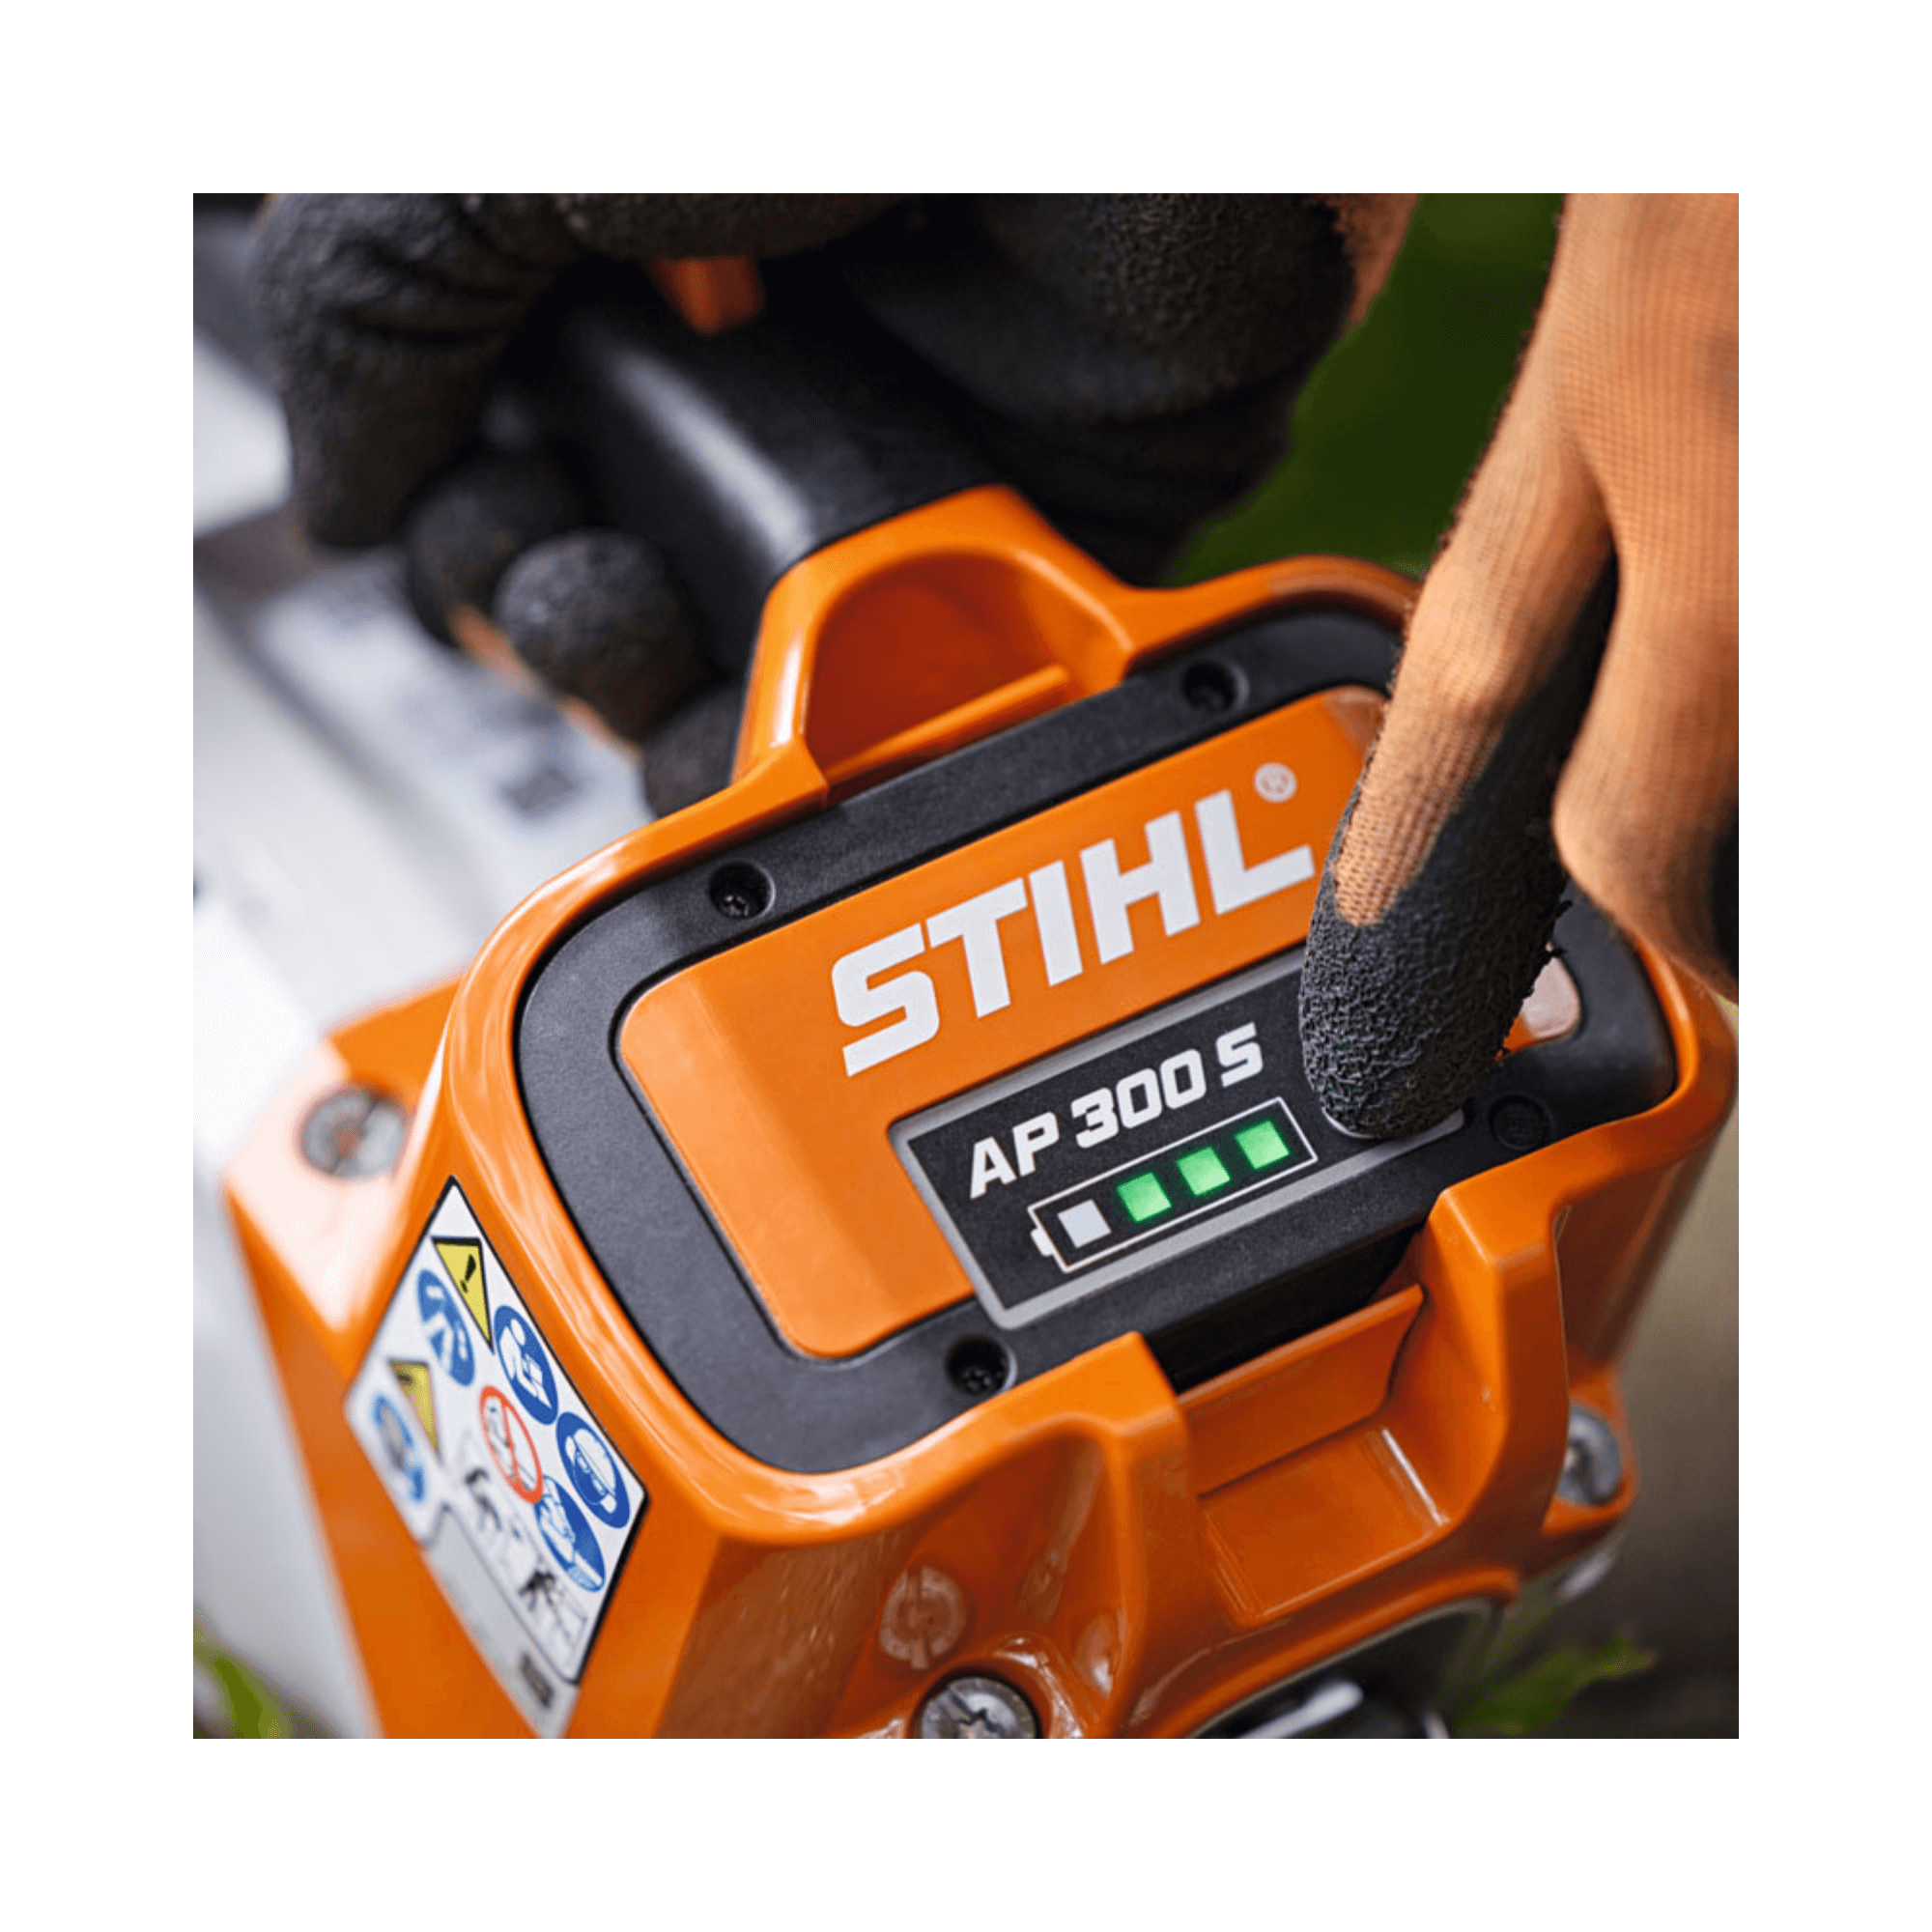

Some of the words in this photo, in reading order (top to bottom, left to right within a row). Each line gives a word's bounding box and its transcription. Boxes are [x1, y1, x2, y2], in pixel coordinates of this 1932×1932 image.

[832, 788, 1315, 1077] STIHL
[970, 1112, 1060, 1199] AP
[1070, 1049, 1207, 1149] 300
[1216, 1022, 1264, 1088] S
